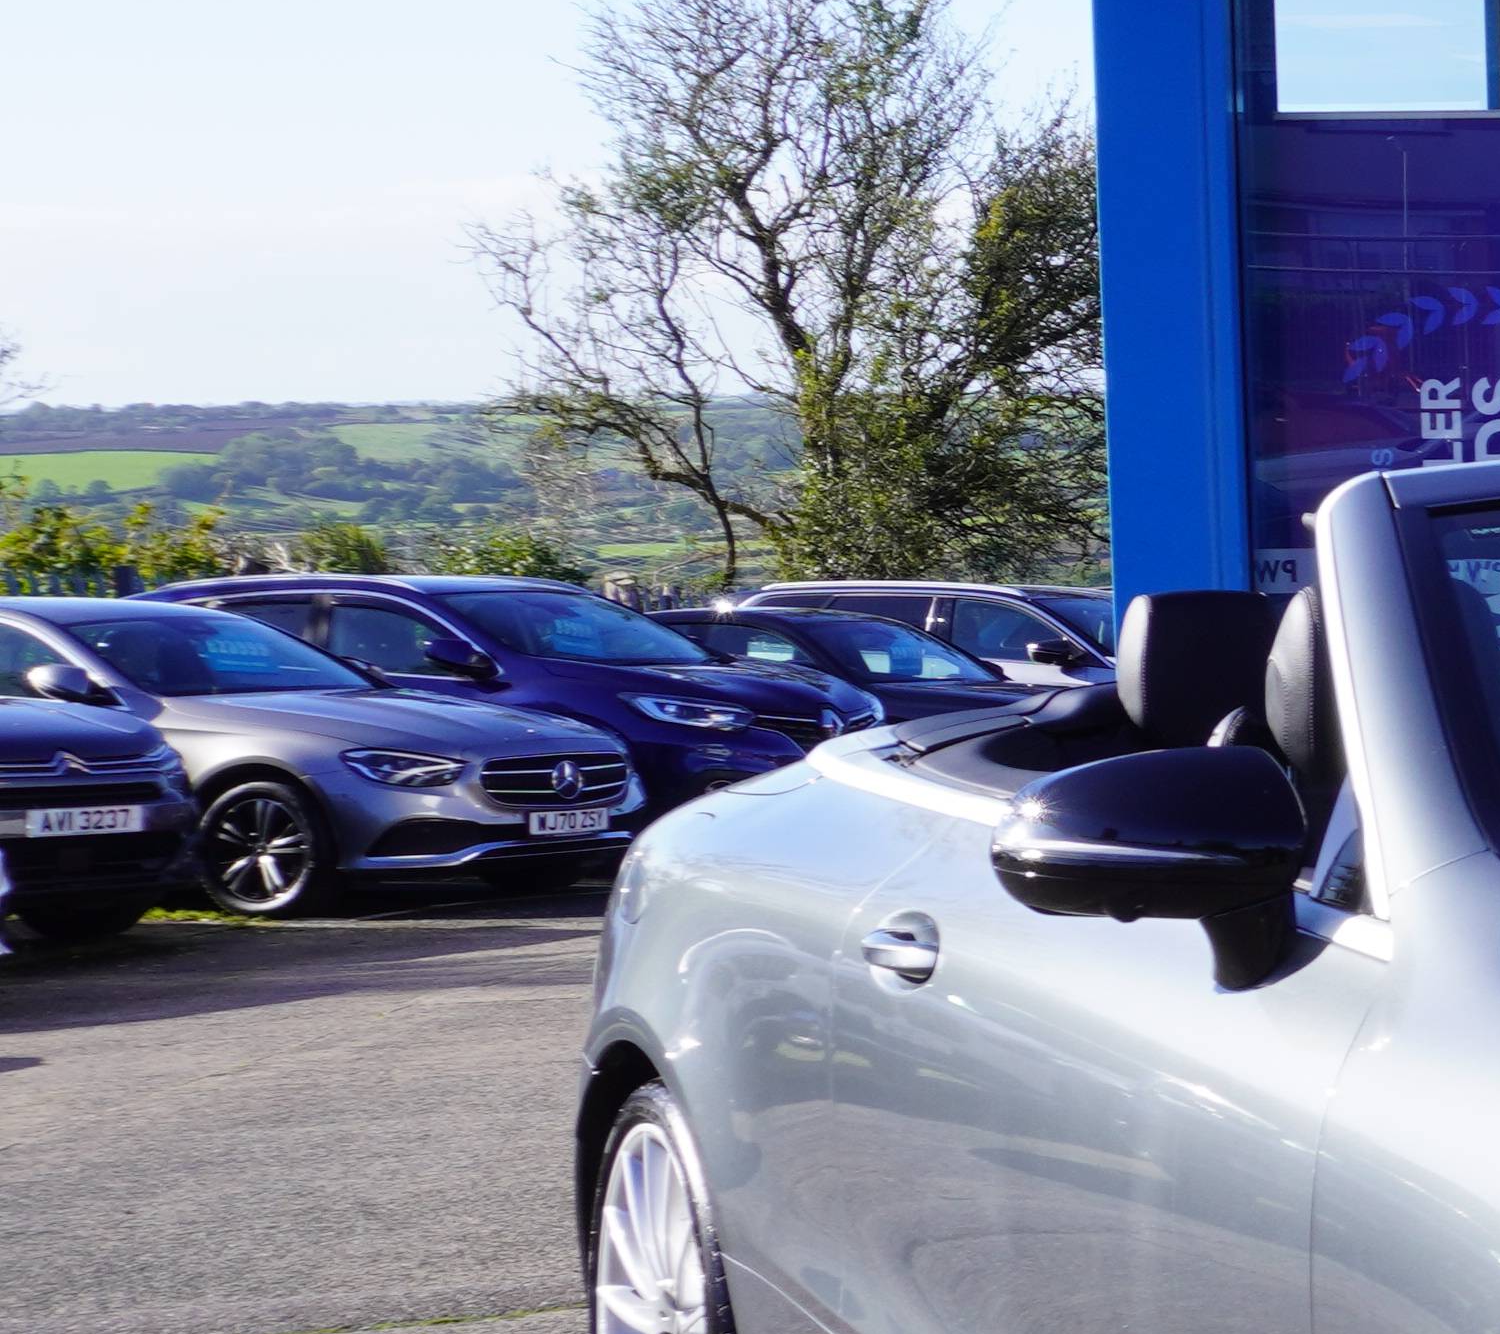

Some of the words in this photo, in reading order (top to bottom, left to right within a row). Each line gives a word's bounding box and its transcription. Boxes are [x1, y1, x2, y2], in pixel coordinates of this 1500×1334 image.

[80, 808, 131, 830] 3237
[538, 812, 577, 831] WJ70
[580, 810, 604, 828] ZSY
